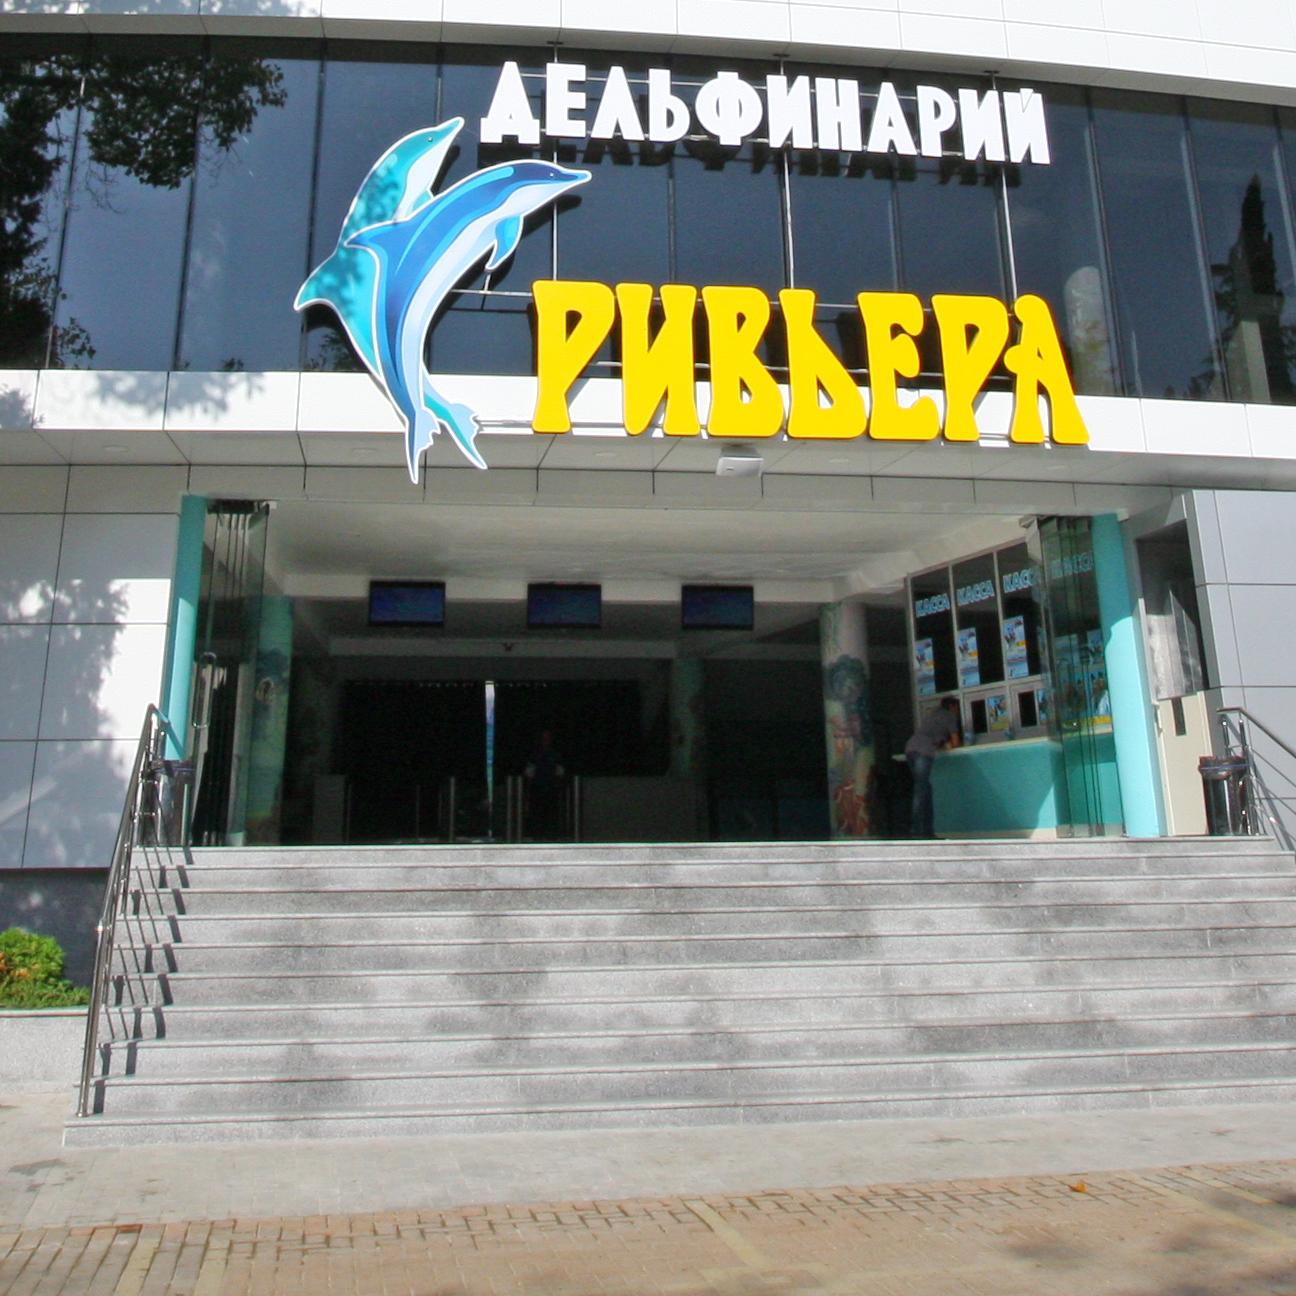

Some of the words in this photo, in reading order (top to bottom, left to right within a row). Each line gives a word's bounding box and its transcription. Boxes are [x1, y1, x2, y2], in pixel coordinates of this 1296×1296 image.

[480, 61, 1050, 164] ДЕЛЬФИНАРИЙ
[531, 280, 1090, 445] РИВЬЕРА
[915, 592, 950, 618] КАССА
[956, 579, 995, 606] КАССА
